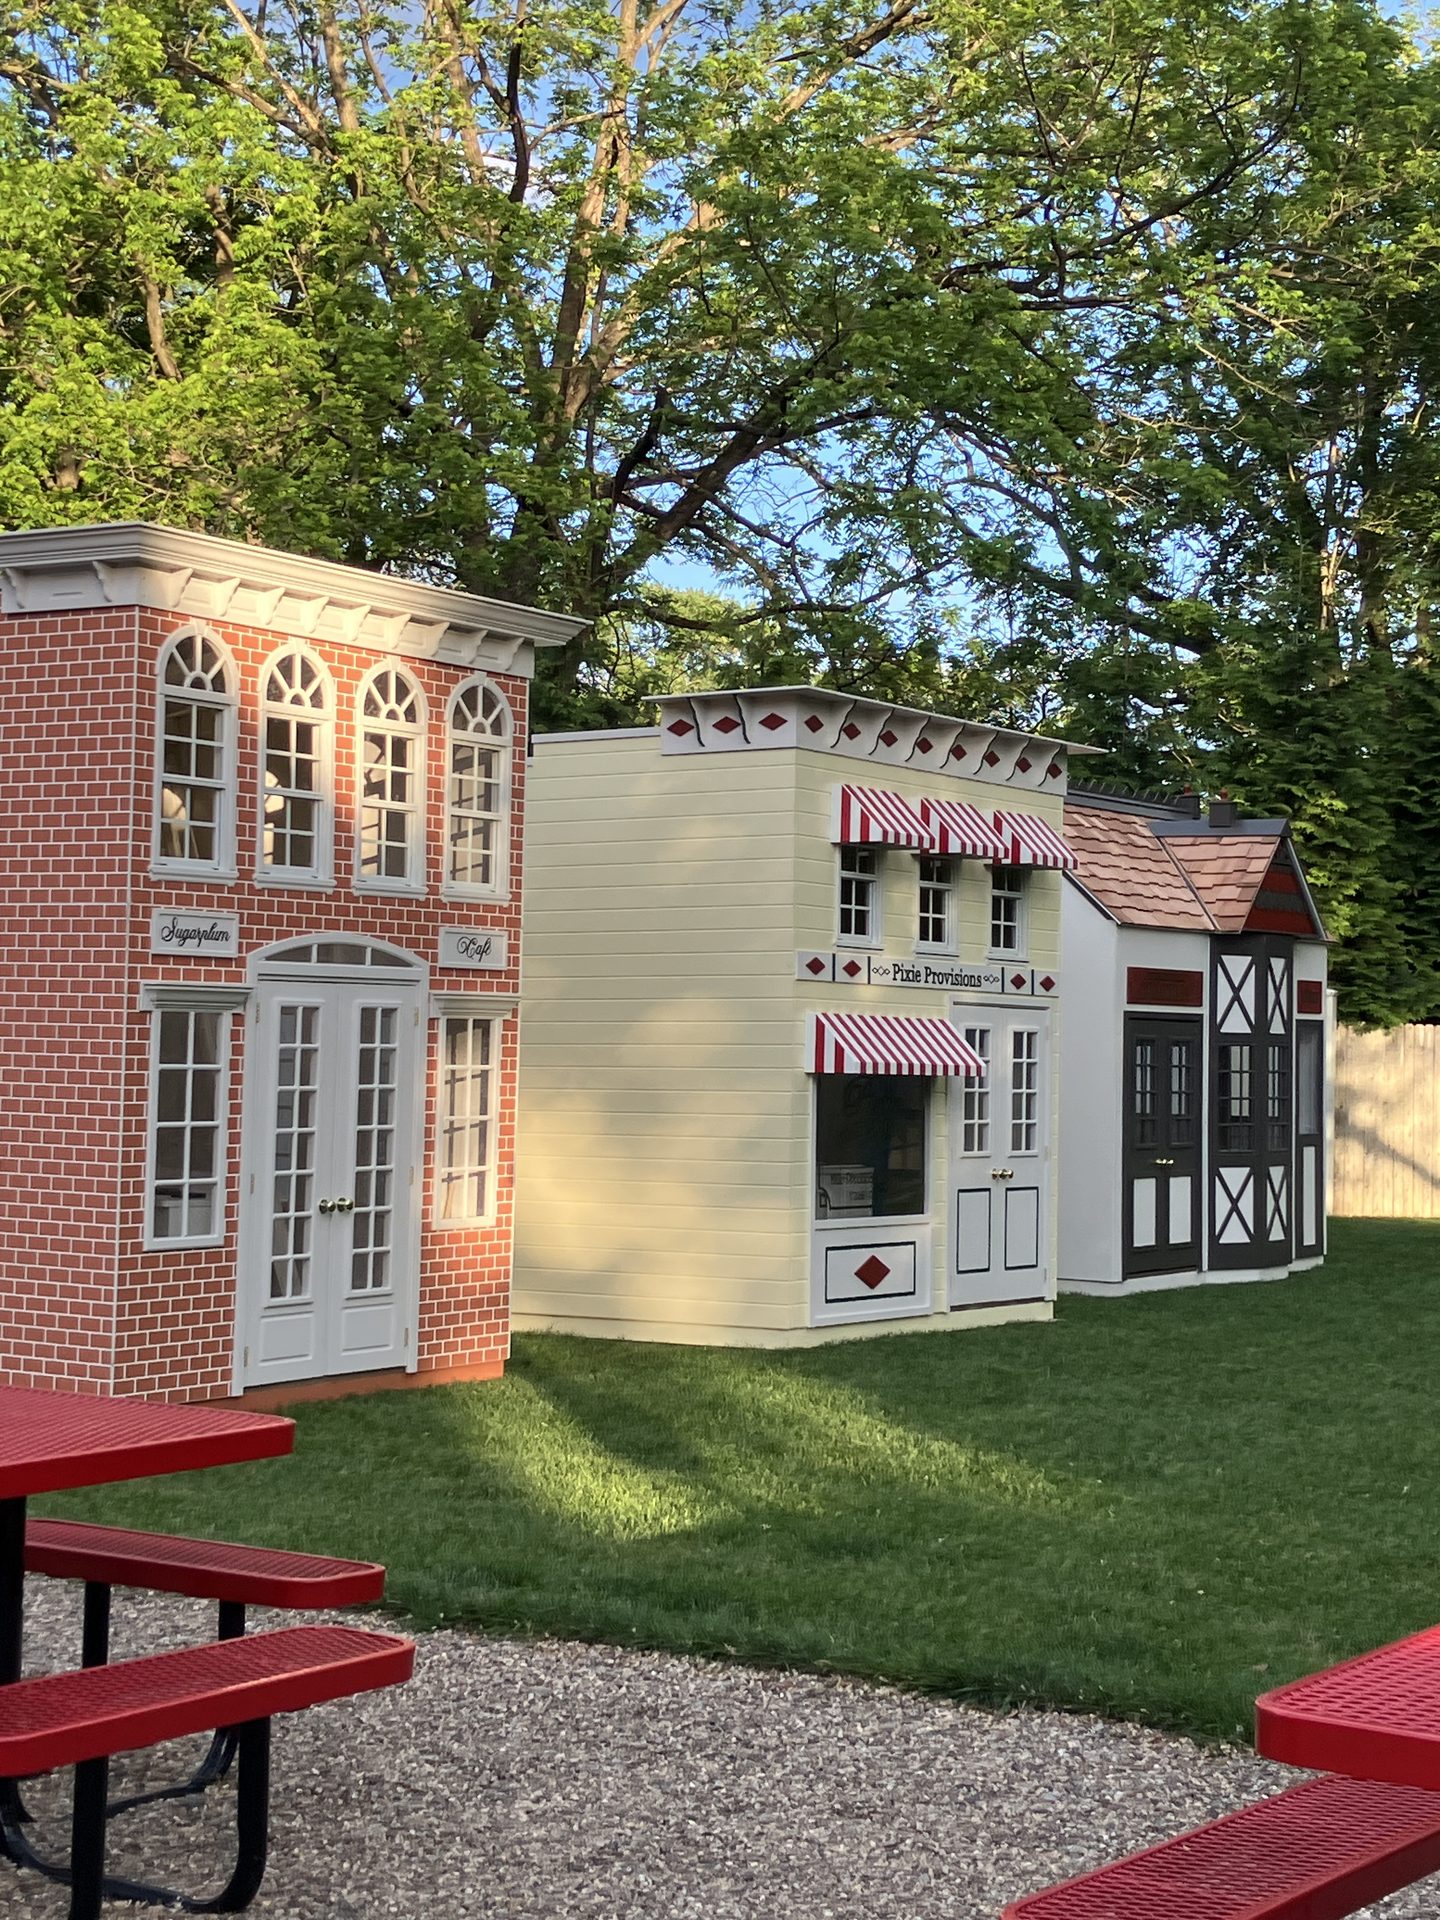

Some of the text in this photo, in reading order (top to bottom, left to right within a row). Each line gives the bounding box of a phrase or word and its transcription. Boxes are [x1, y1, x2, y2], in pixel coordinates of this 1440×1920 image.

[161, 916, 231, 948] Sugarplum
[892, 963, 983, 988] Pixie Provisions
